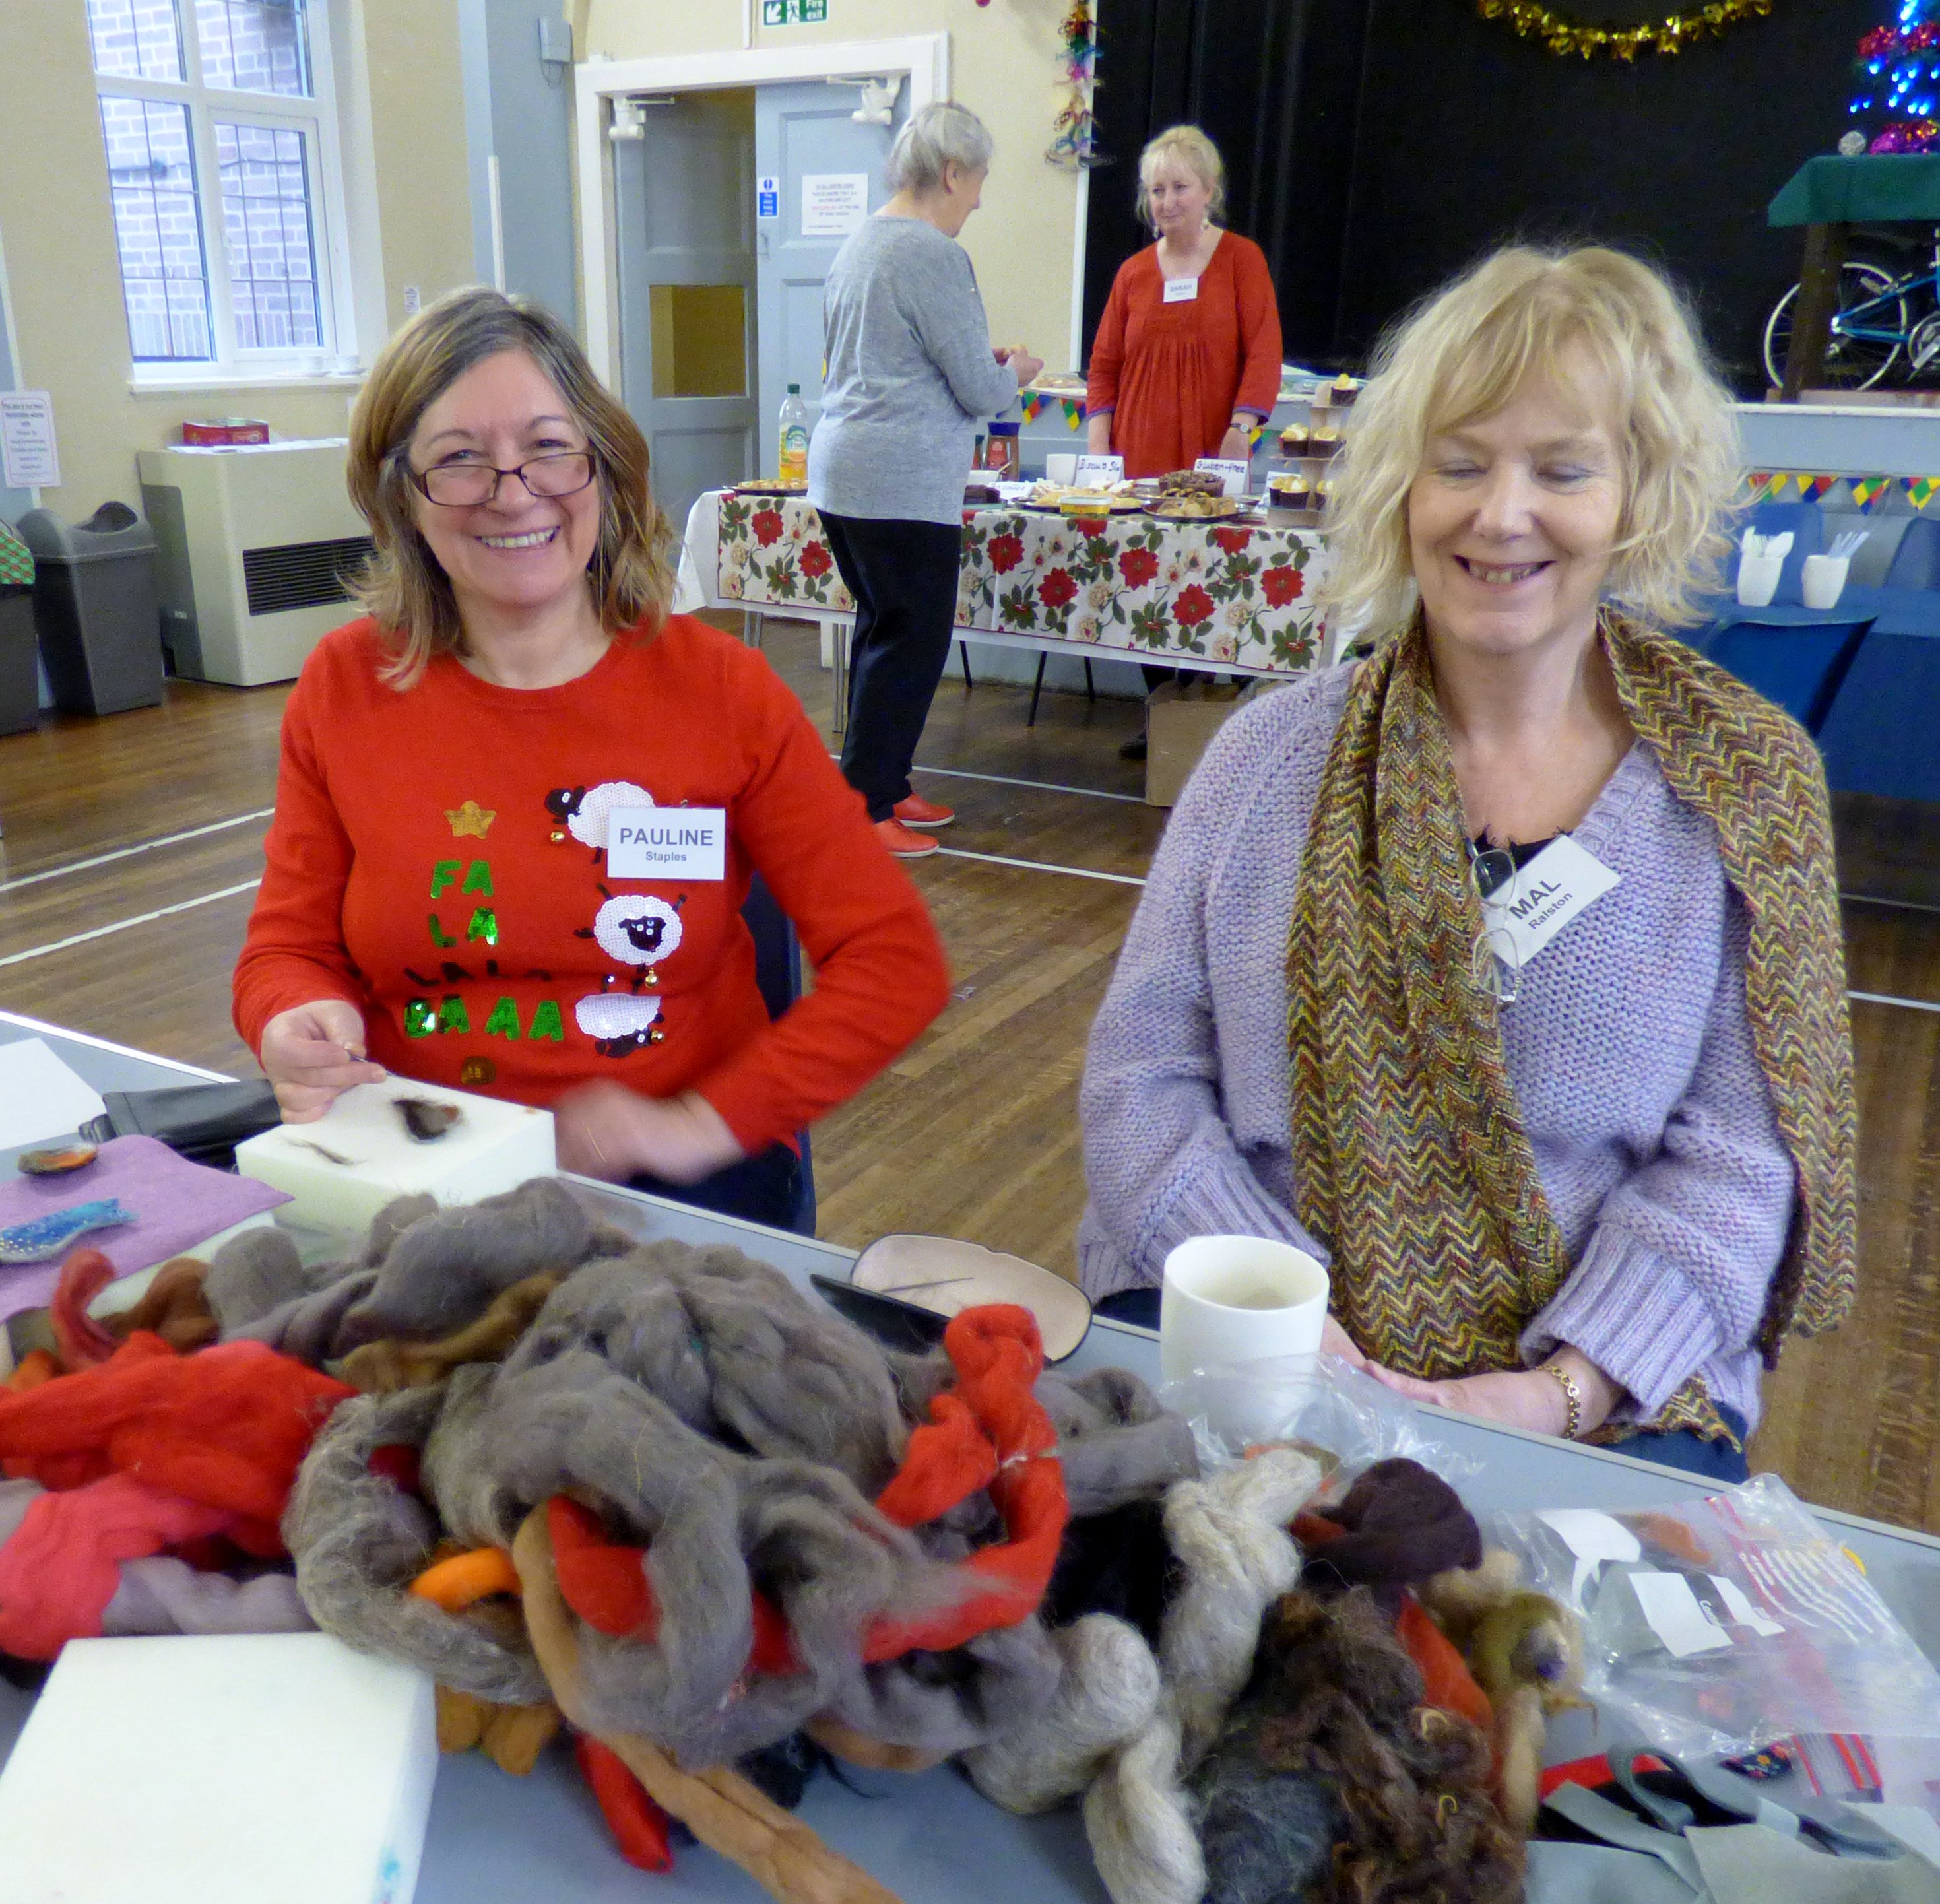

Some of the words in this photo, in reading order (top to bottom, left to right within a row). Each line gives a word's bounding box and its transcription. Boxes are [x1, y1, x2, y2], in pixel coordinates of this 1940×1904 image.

[806, 9, 824, 20] exit
[619, 827, 714, 846] PAULINE
[645, 851, 688, 863] Staples
[430, 860, 494, 898] FA
[1508, 880, 1563, 920] MAL
[1528, 892, 1573, 930] Ralston
[428, 907, 499, 946] LA
